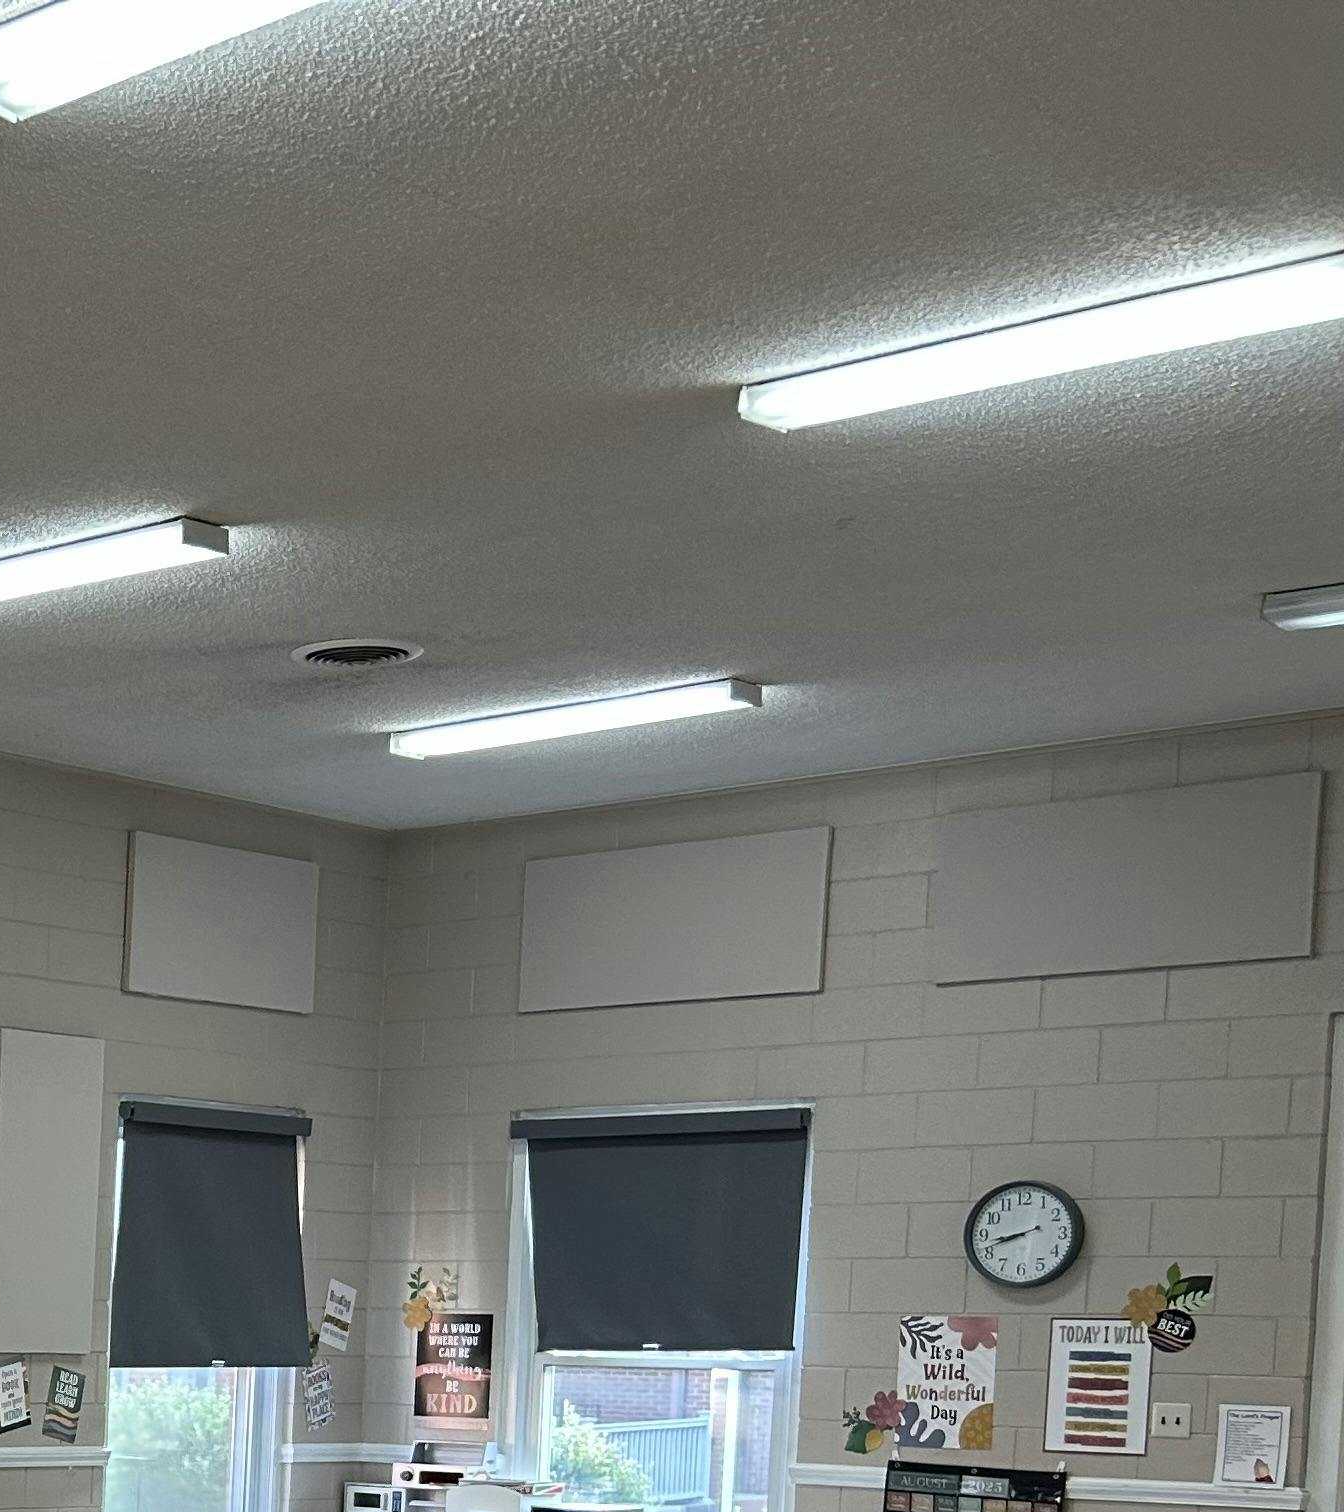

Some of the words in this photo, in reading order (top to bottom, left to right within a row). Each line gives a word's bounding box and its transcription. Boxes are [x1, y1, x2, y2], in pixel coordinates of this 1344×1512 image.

[1001, 1198, 1012, 1212] 11
[1016, 1191, 1032, 1206] 12
[1040, 1195, 1047, 1210] 1
[986, 1211, 1001, 1225] 10
[1051, 1207, 1061, 1222] 2
[979, 1228, 989, 1242] 9
[1057, 1225, 1068, 1240] 3
[984, 1246, 994, 1260] 8
[1050, 1244, 1060, 1258] 4
[998, 1257, 1008, 1272] 7
[1016, 1262, 1027, 1276] 6
[1035, 1257, 1046, 1272] 5
[429, 1322, 440, 1334] IN
[441, 1323, 448, 1334] A
[450, 1322, 481, 1334] WORLD
[1058, 1325, 1101, 1344] TODAY
[1103, 1326, 1110, 1343] I
[1114, 1326, 1146, 1345] WILL
[1157, 1318, 1190, 1338] BEST
[428, 1335, 459, 1346] WHERE
[460, 1336, 478, 1346] YOU
[438, 1347, 456, 1358] CAN
[458, 1347, 470, 1358] BE
[929, 1344, 953, 1361] It's
[956, 1348, 964, 1360] a
[422, 1360, 482, 1380] anything
[923, 1362, 970, 1382] Wild,
[59, 1370, 79, 1386] READ
[55, 1381, 78, 1398] LEARN
[445, 1380, 459, 1392] BE
[905, 1383, 986, 1402] Wonderful
[426, 1393, 478, 1414] KIND
[930, 1404, 958, 1426] Day
[901, 1475, 949, 1490] AUGUST
[967, 1480, 1003, 1493] 2025
